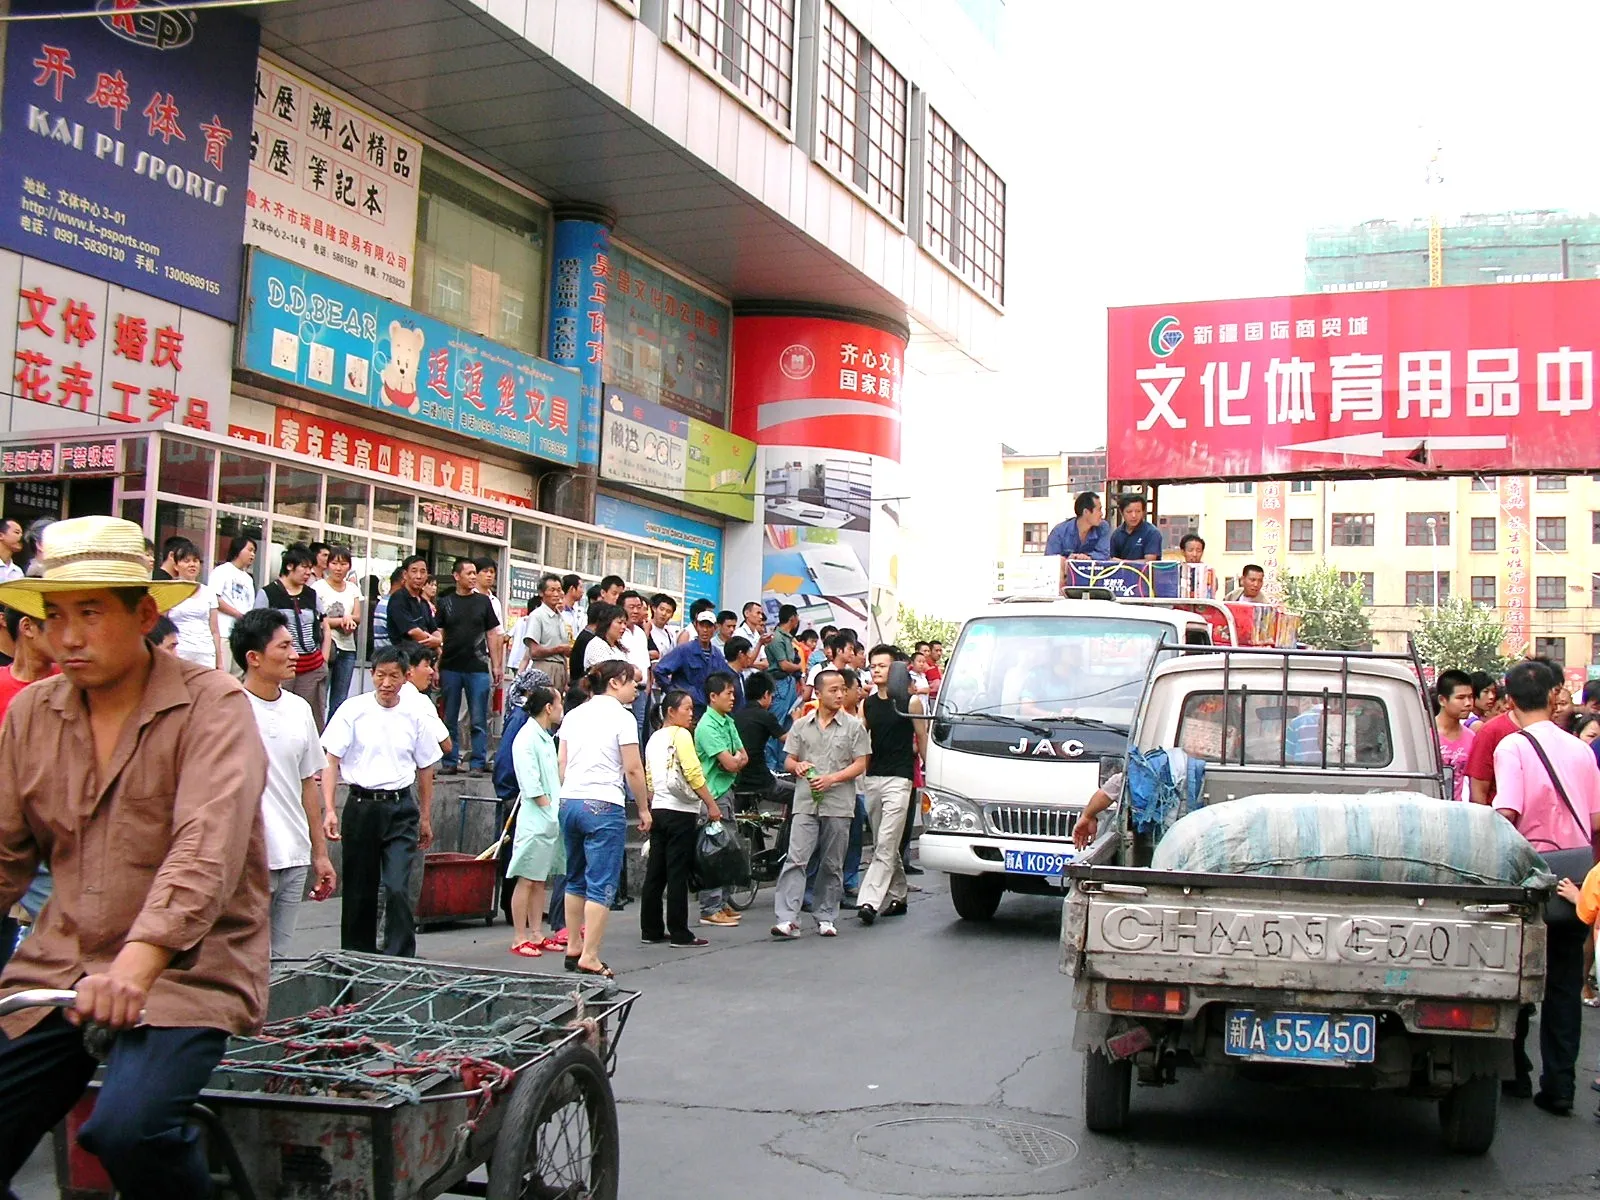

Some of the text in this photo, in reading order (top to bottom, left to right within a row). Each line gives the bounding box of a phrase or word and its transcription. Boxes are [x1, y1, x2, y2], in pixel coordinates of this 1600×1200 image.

[28, 104, 228, 207] KAI PI SPORTS
[18, 285, 185, 373] 文体 婚庆
[1193, 316, 1368, 345] 新疆国际商贸城
[15, 349, 211, 432] 花卉 工艺品
[1135, 346, 1593, 431] 文化体育用品中
[60, 445, 116, 469] 严禁吸烟
[1009, 738, 1084, 757] JAC
[1102, 905, 1507, 969] CHANGAN
[1230, 1016, 1371, 1055] 新A 55450
